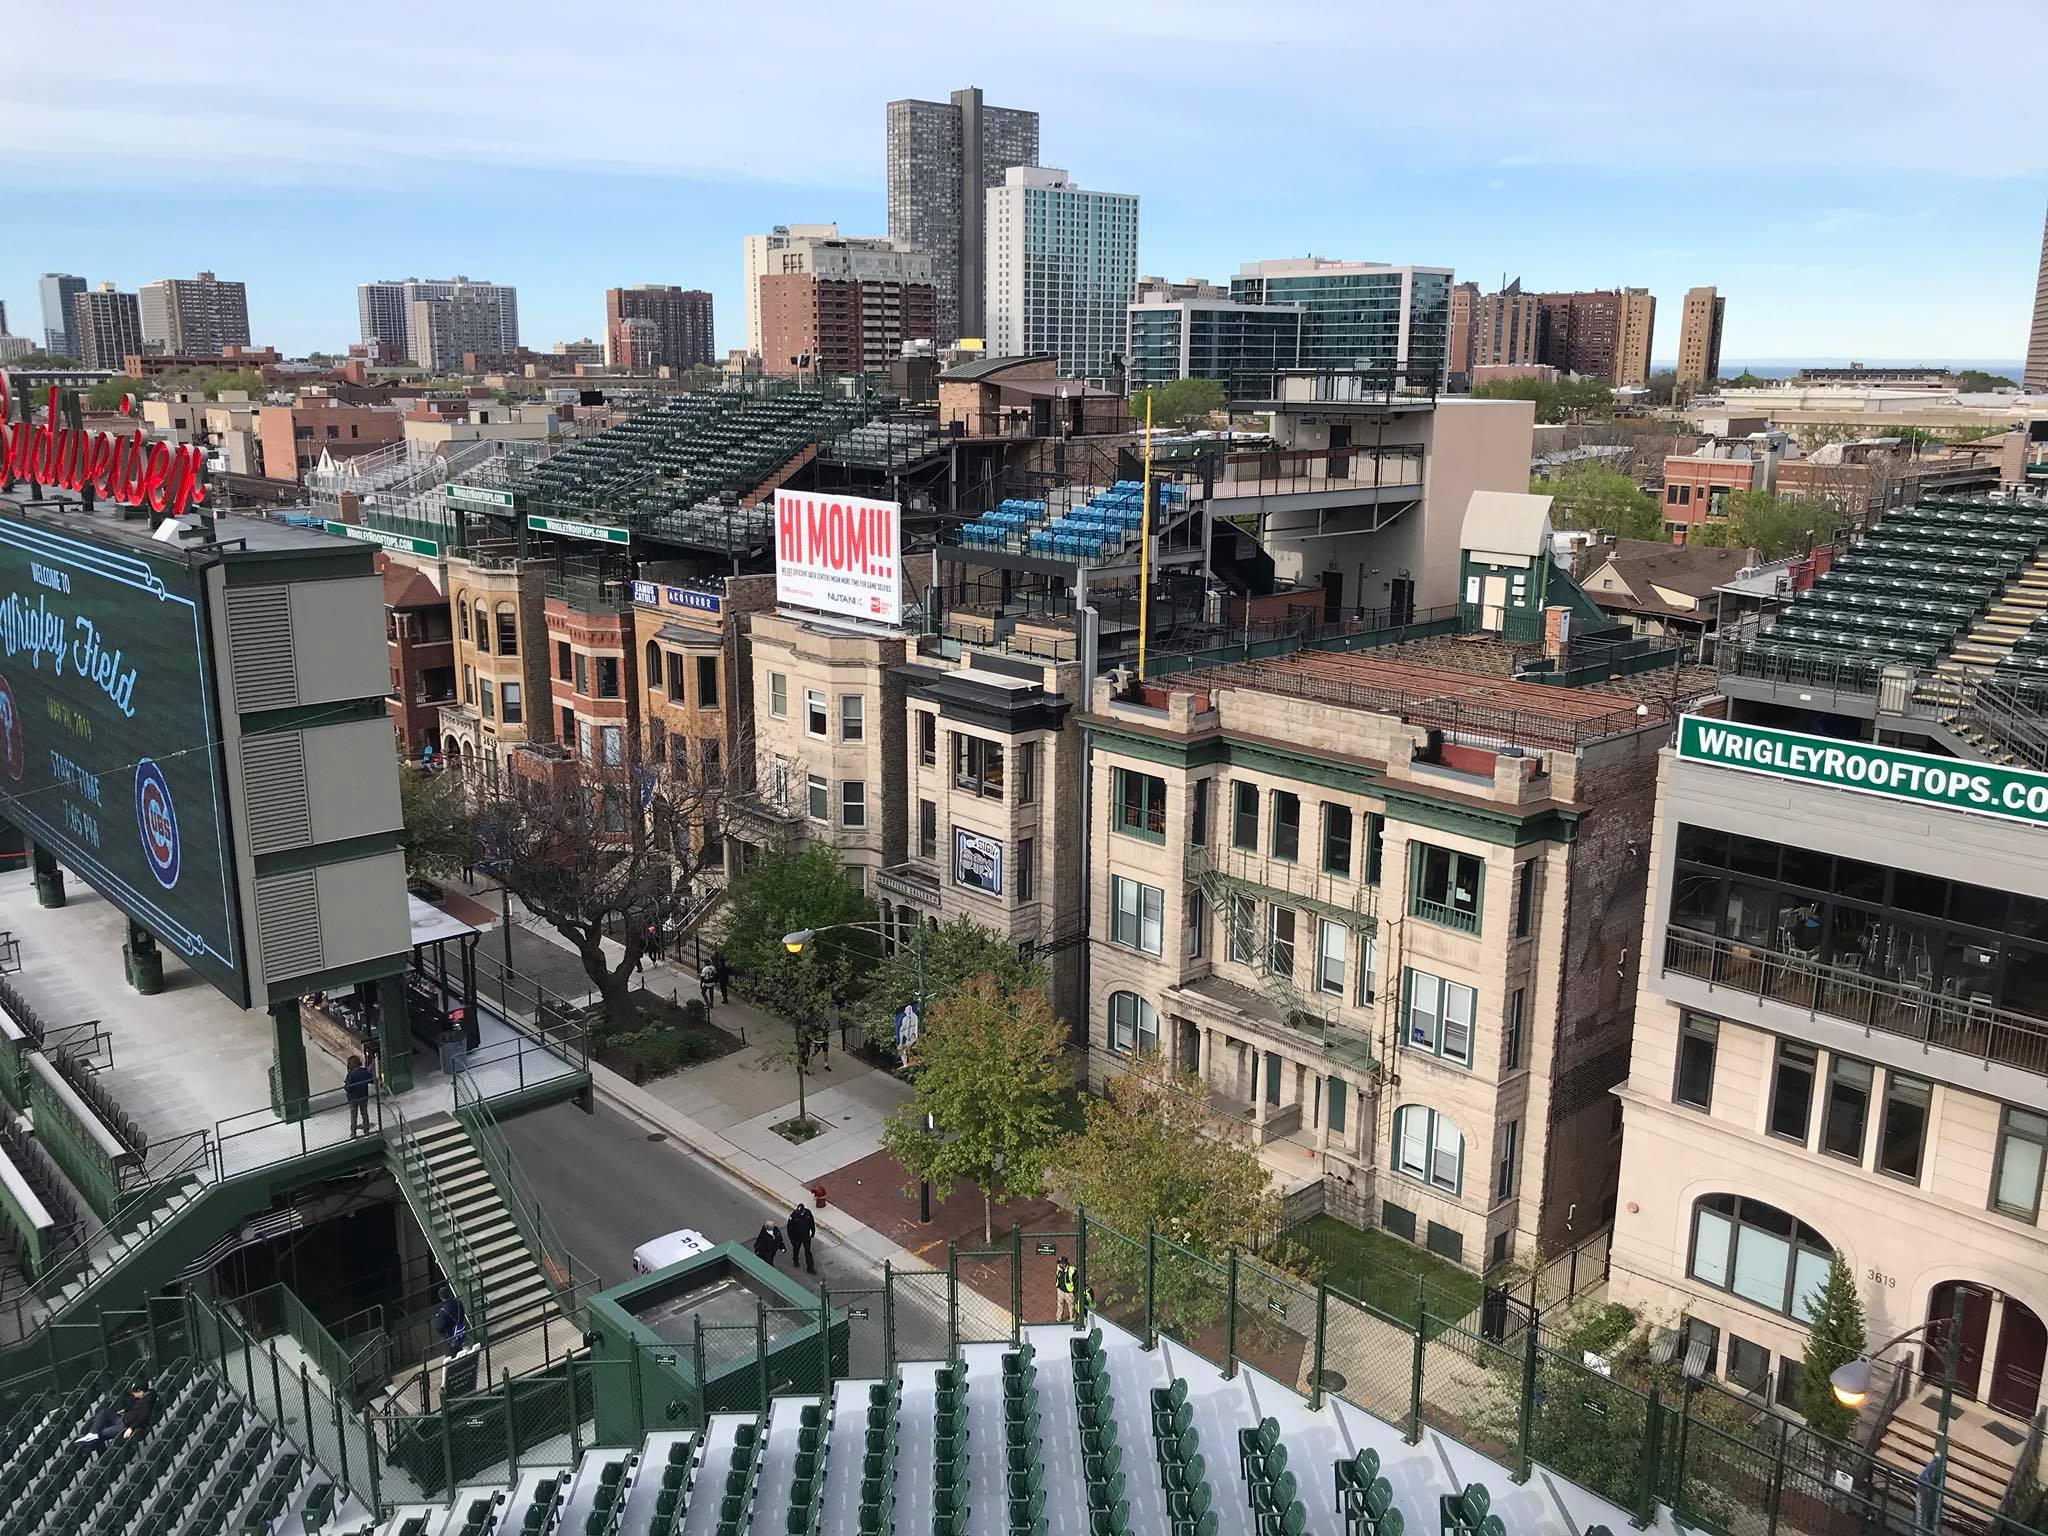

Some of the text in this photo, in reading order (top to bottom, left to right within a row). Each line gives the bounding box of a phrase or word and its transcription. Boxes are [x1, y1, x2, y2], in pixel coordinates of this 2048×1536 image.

[452, 487, 506, 504] WRIGLEYROOFTOPS.COM
[345, 526, 414, 551] WRIGLEYROOFTOPS.COM
[545, 519, 609, 539] WRIGLEYROOFTOPS.COM
[780, 498, 891, 578] HI MOM!!!
[31, 562, 70, 595] WELCOME TO
[634, 582, 655, 595] EAMUS
[793, 568, 807, 577] EFFICIENT
[808, 570, 816, 578] DATA
[817, 572, 830, 581] CENTERS
[831, 574, 840, 583] MEAN
[841, 576, 850, 585] MORE
[851, 578, 859, 587] TIME
[867, 581, 877, 590] GAME
[0, 592, 137, 718] Wrigley Field
[50, 749, 102, 808] START TIME
[1867, 1269, 1896, 1289] 3619
